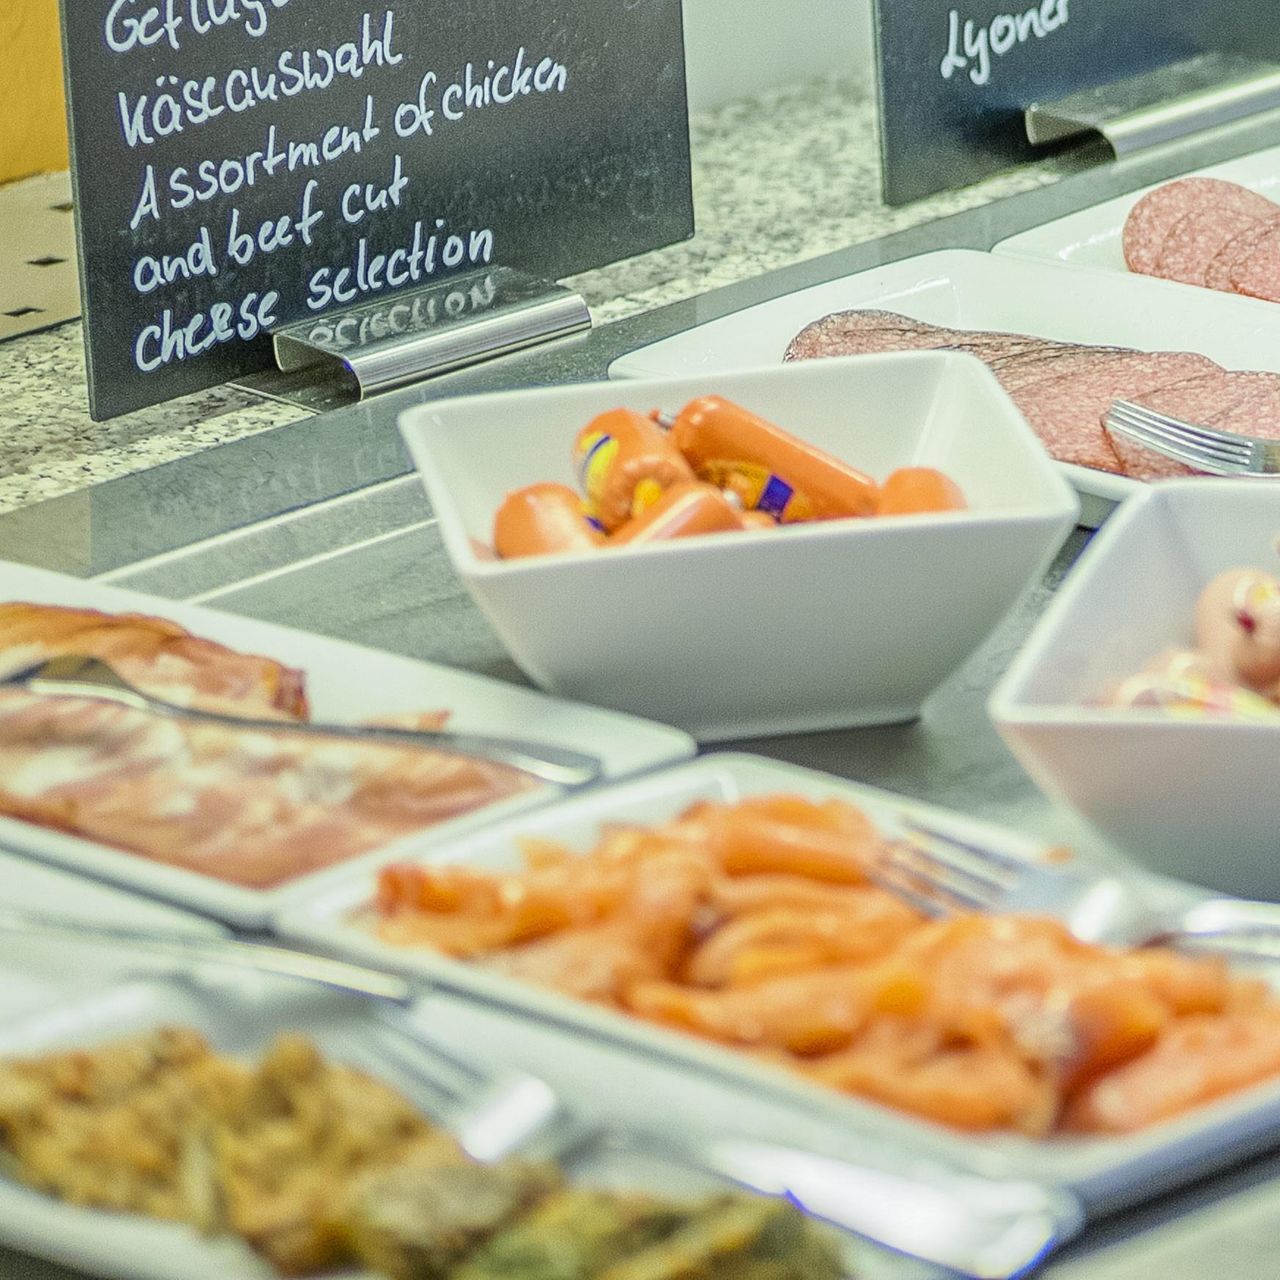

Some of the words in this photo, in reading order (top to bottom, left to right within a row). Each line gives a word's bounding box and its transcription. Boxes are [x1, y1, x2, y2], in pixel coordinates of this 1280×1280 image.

[118, 10, 403, 149] Käseauswahl
[131, 96, 381, 228] Assortment
[395, 73, 435, 138] of
[441, 46, 567, 120] chicken
[135, 226, 217, 294] and
[228, 180, 323, 261] beef
[342, 156, 409, 222] cut
[308, 217, 494, 310] selection
